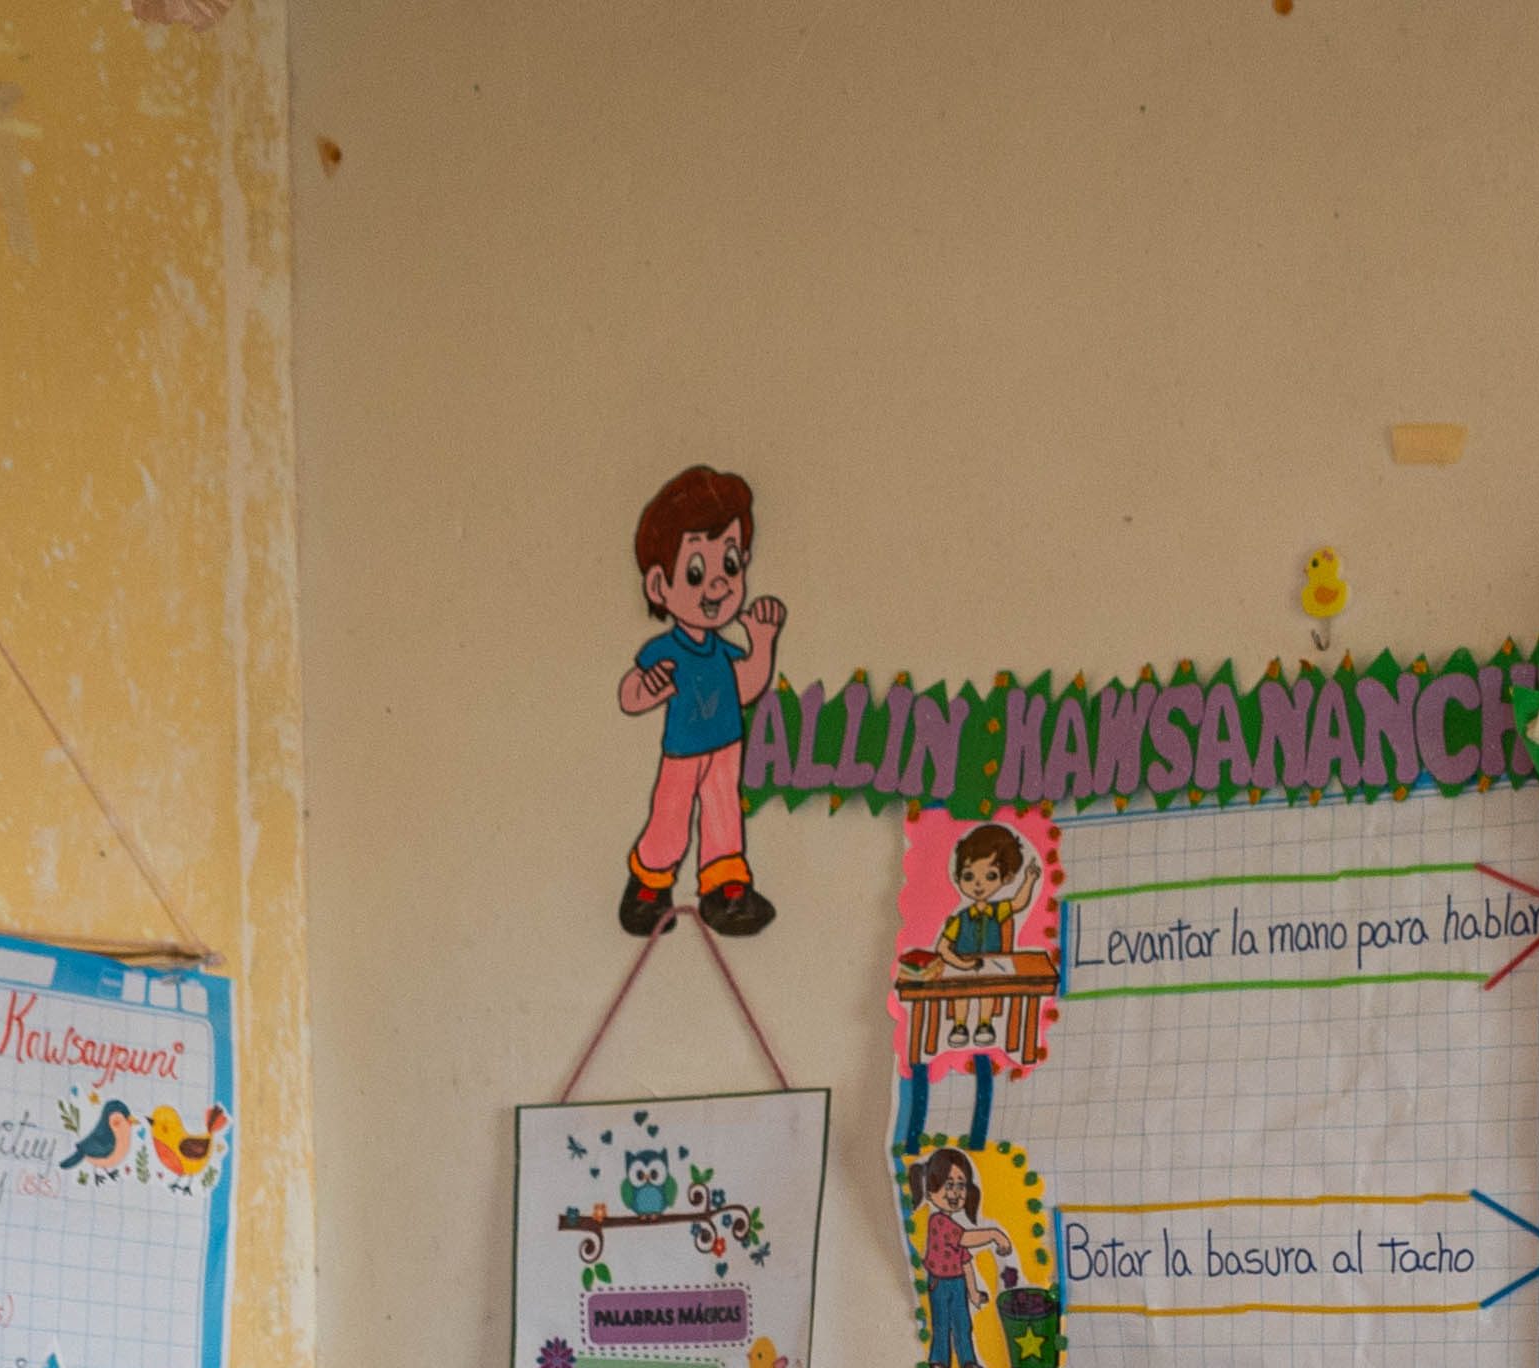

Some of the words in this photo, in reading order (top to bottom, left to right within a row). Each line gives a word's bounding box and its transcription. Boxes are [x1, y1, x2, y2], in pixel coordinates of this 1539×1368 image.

[742, 678, 971, 798] ALLIN
[1073, 903, 1220, 966] Levantar
[1230, 903, 1261, 954] la
[1267, 919, 1348, 954] mano
[1357, 917, 1429, 969] para
[1066, 1224, 1153, 1281] Botar
[1163, 1228, 1192, 1278] la
[1207, 1230, 1317, 1278] basura
[1333, 1230, 1363, 1274] al
[594, 1306, 674, 1330] PALABRAS
